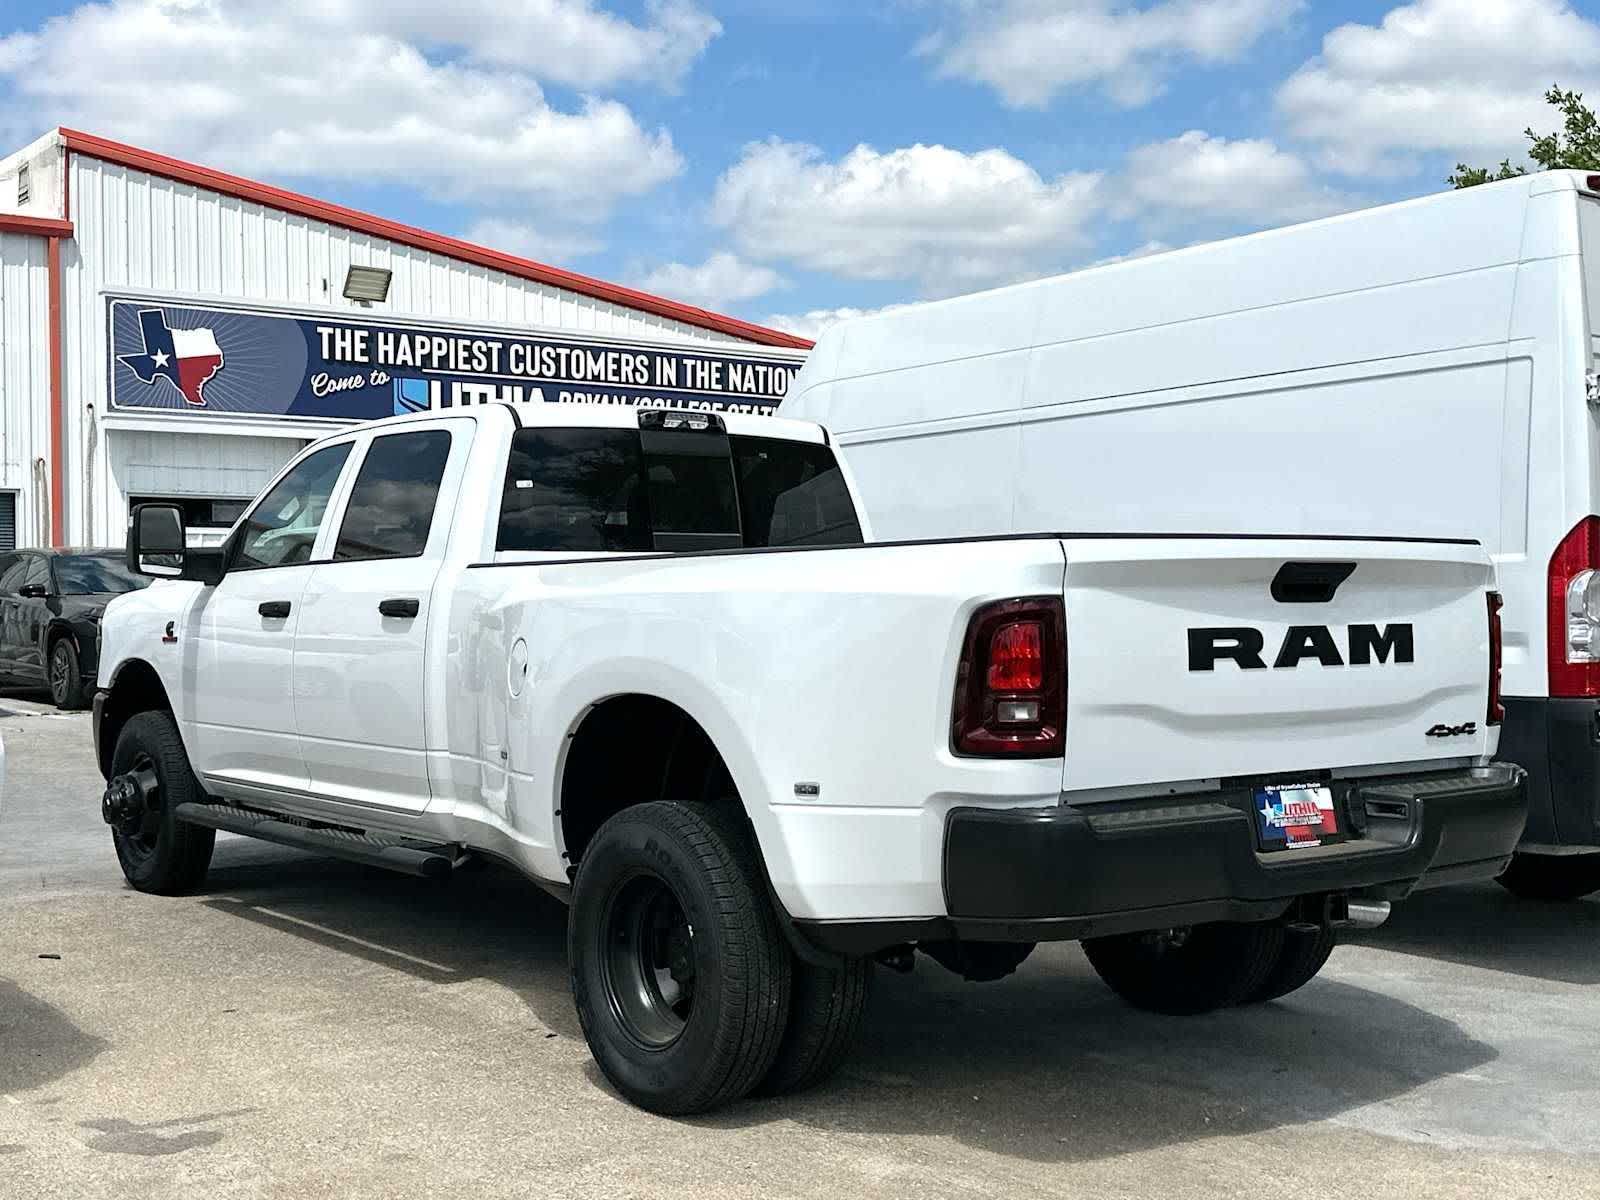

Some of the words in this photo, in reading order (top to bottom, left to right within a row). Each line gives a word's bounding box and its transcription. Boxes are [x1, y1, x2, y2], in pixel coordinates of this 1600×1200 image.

[311, 371, 365, 397] Come
[369, 368, 391, 386] to
[317, 326, 369, 363] THE
[377, 328, 502, 373] HAPPIEST
[509, 343, 649, 384] CUSTOMERS
[655, 356, 677, 387] IN
[683, 358, 723, 391] THE
[1187, 623, 1414, 672] RAM
